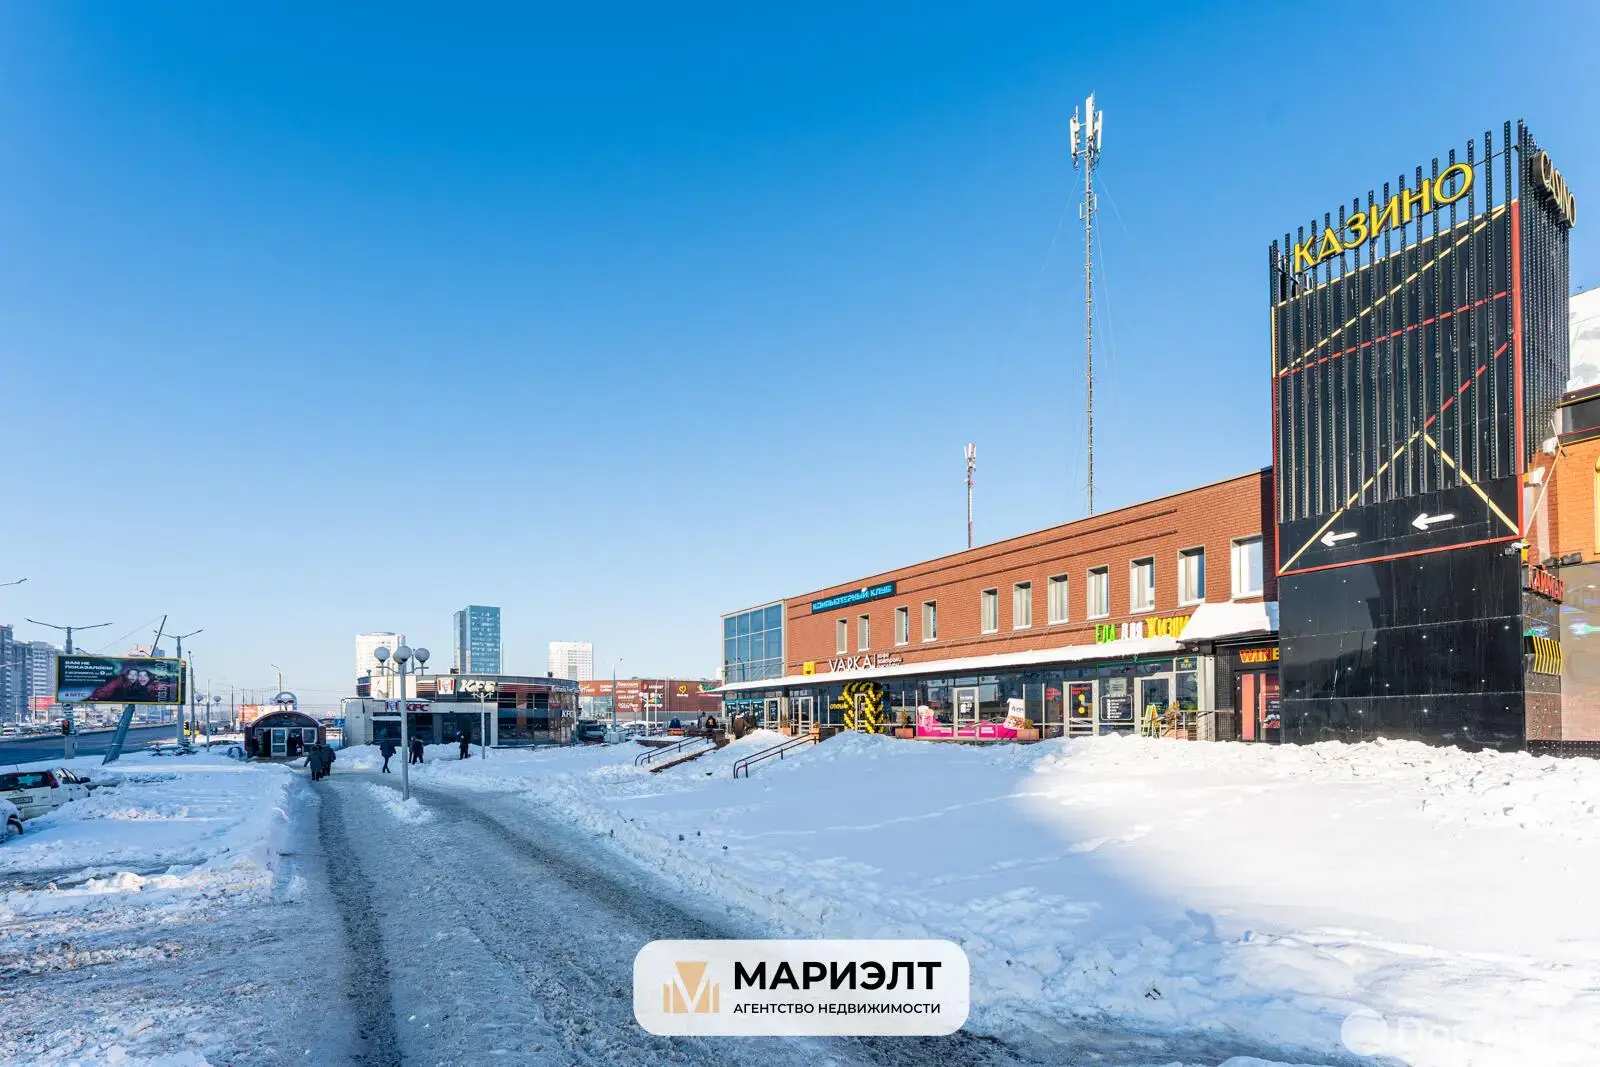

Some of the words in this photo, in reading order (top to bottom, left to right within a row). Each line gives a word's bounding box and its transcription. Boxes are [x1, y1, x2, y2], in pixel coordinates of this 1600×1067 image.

[1294, 162, 1475, 273] КАЗИНО
[813, 589, 870, 610] КОМПЬЮТЕРНЫЙ
[870, 585, 893, 598] КЛУБ
[829, 654, 872, 672] VARKA
[459, 680, 496, 693] KFC
[406, 703, 430, 712] KFC
